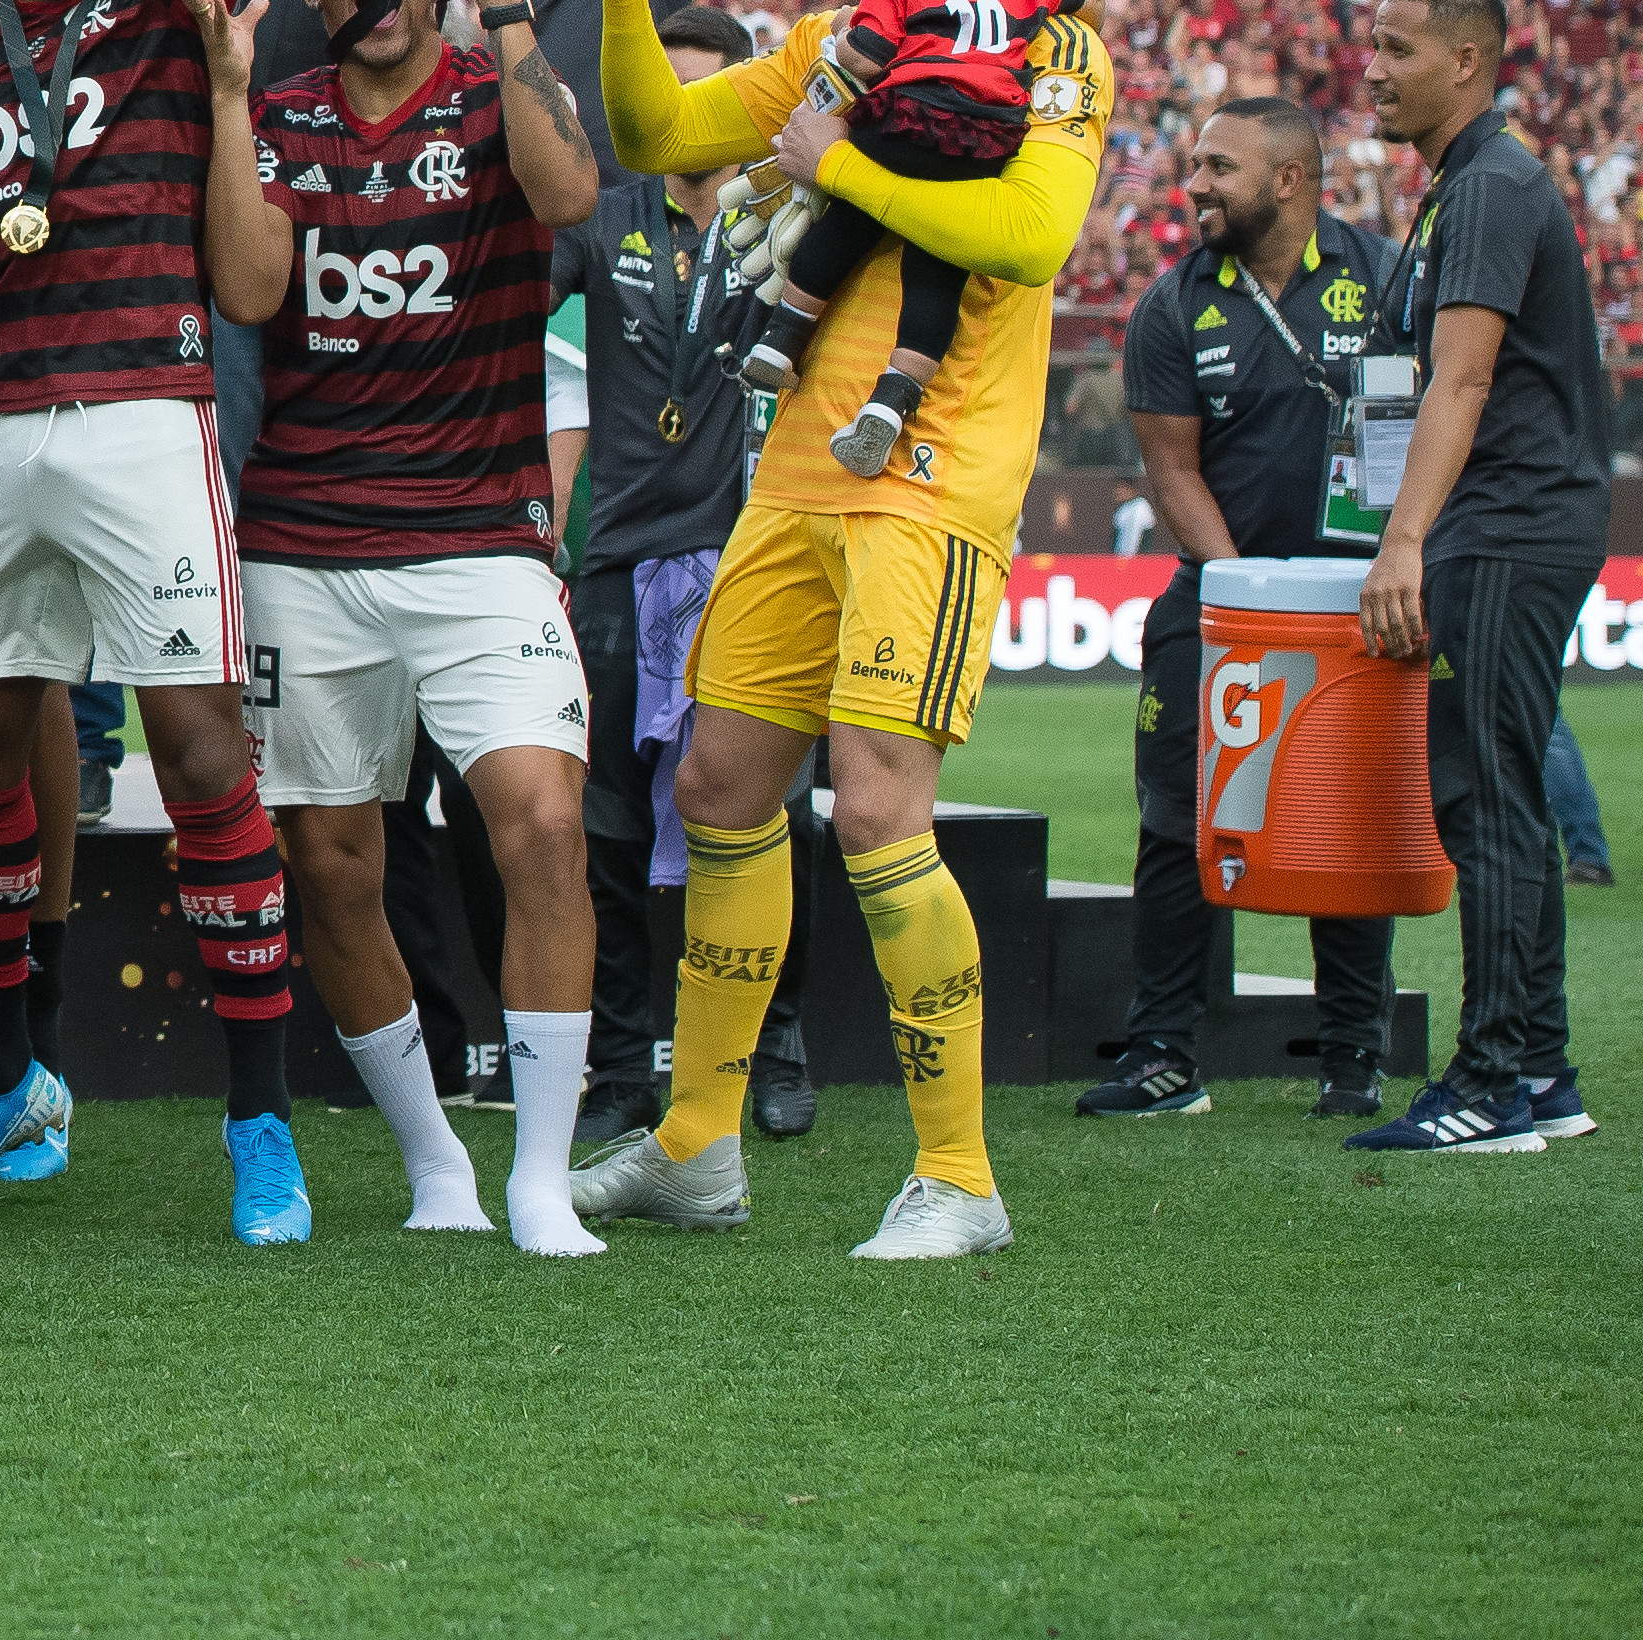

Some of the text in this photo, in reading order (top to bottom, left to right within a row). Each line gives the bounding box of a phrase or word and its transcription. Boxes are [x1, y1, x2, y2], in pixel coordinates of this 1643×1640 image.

[305, 227, 454, 320] bs2
[308, 331, 360, 353] Banco
[152, 583, 218, 601] Benevix
[991, 574, 1143, 673] ube
[850, 660, 915, 686] Benevix
[1209, 661, 1261, 749] G
[179, 892, 238, 912] EITE
[185, 909, 247, 929] YAL
[226, 943, 283, 966] CRF
[689, 935, 779, 964] ZEITE
[685, 951, 782, 984] OYAL
[908, 960, 982, 1002] AZEI
[909, 983, 982, 1017] ROY
